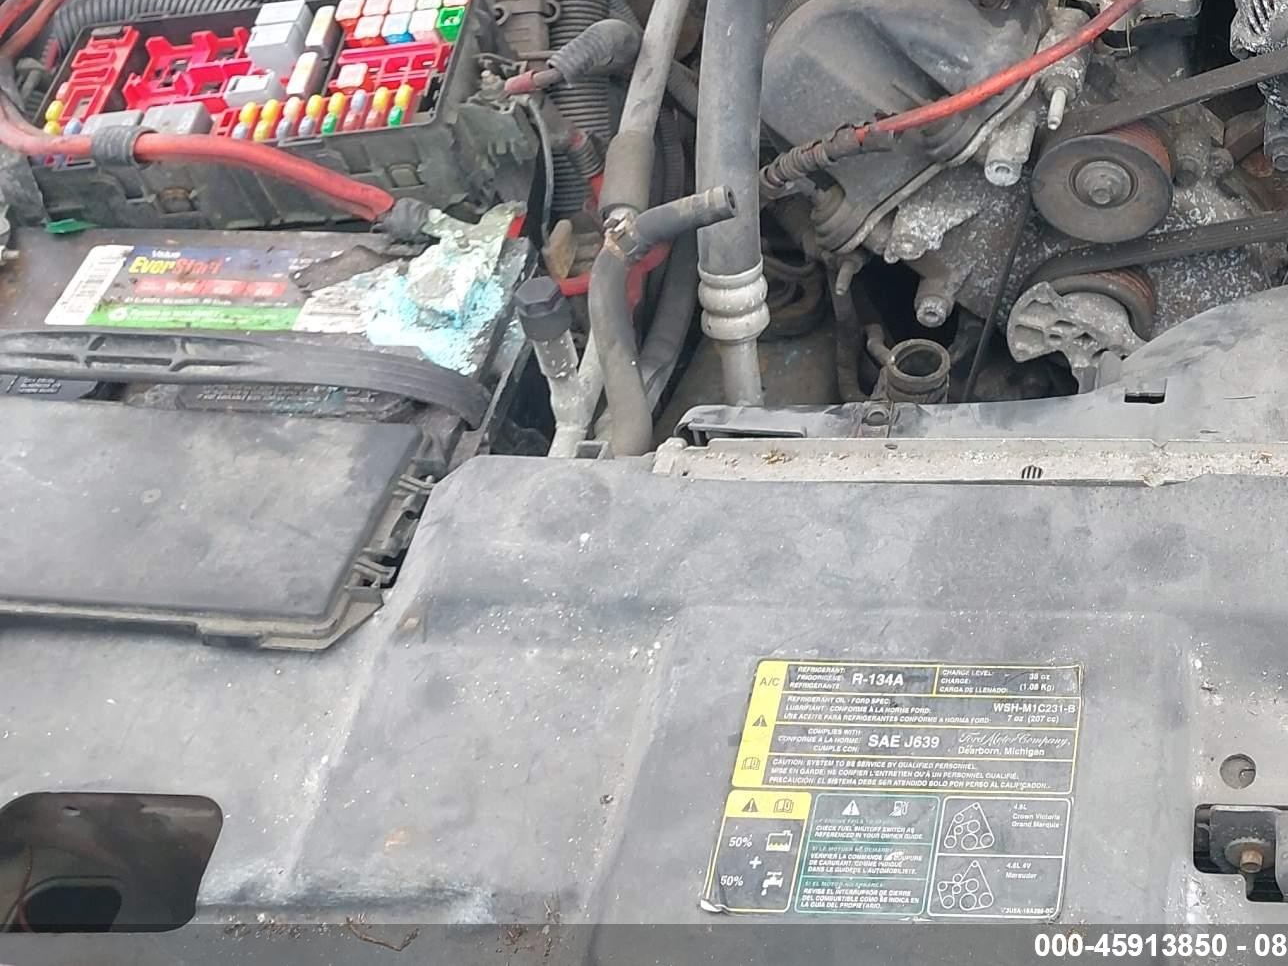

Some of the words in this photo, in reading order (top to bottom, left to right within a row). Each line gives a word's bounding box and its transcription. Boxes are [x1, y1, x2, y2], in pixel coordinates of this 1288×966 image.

[128, 256, 222, 275] EverStart
[760, 677, 780, 686] A/C
[852, 673, 904, 686] R-134A
[993, 703, 1076, 713] WSH-M1C231-B
[868, 734, 901, 748] SAE
[904, 735, 940, 748] J639
[958, 732, 986, 745] Ford
[982, 732, 1015, 746] Motor
[1004, 747, 1045, 757] Michigan
[728, 836, 752, 848] 50%
[720, 875, 744, 886] 50%
